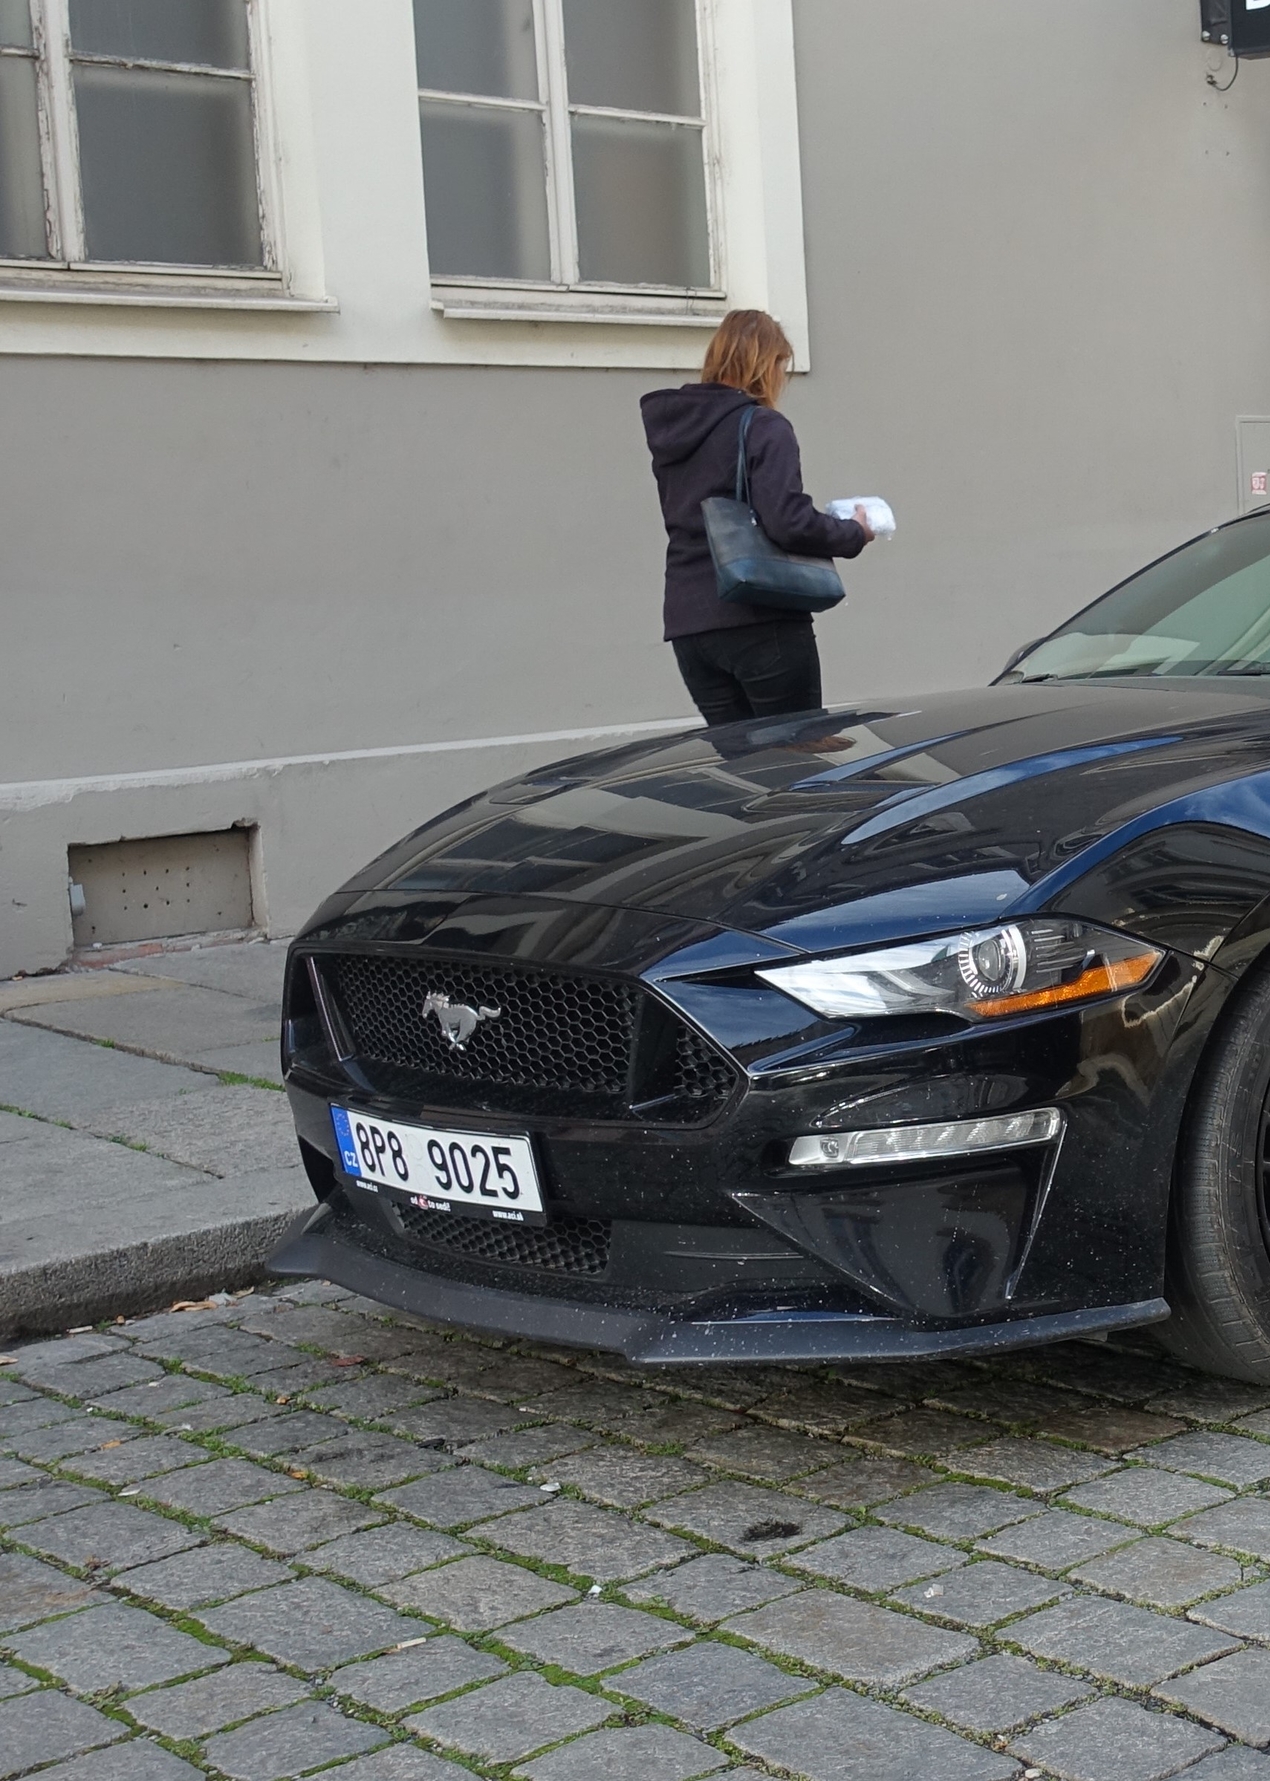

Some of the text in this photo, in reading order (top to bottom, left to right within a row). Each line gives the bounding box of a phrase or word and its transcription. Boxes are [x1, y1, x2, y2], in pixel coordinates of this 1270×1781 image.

[344, 1150, 359, 1168] CZ
[356, 1122, 520, 1200] 8P8 9025
